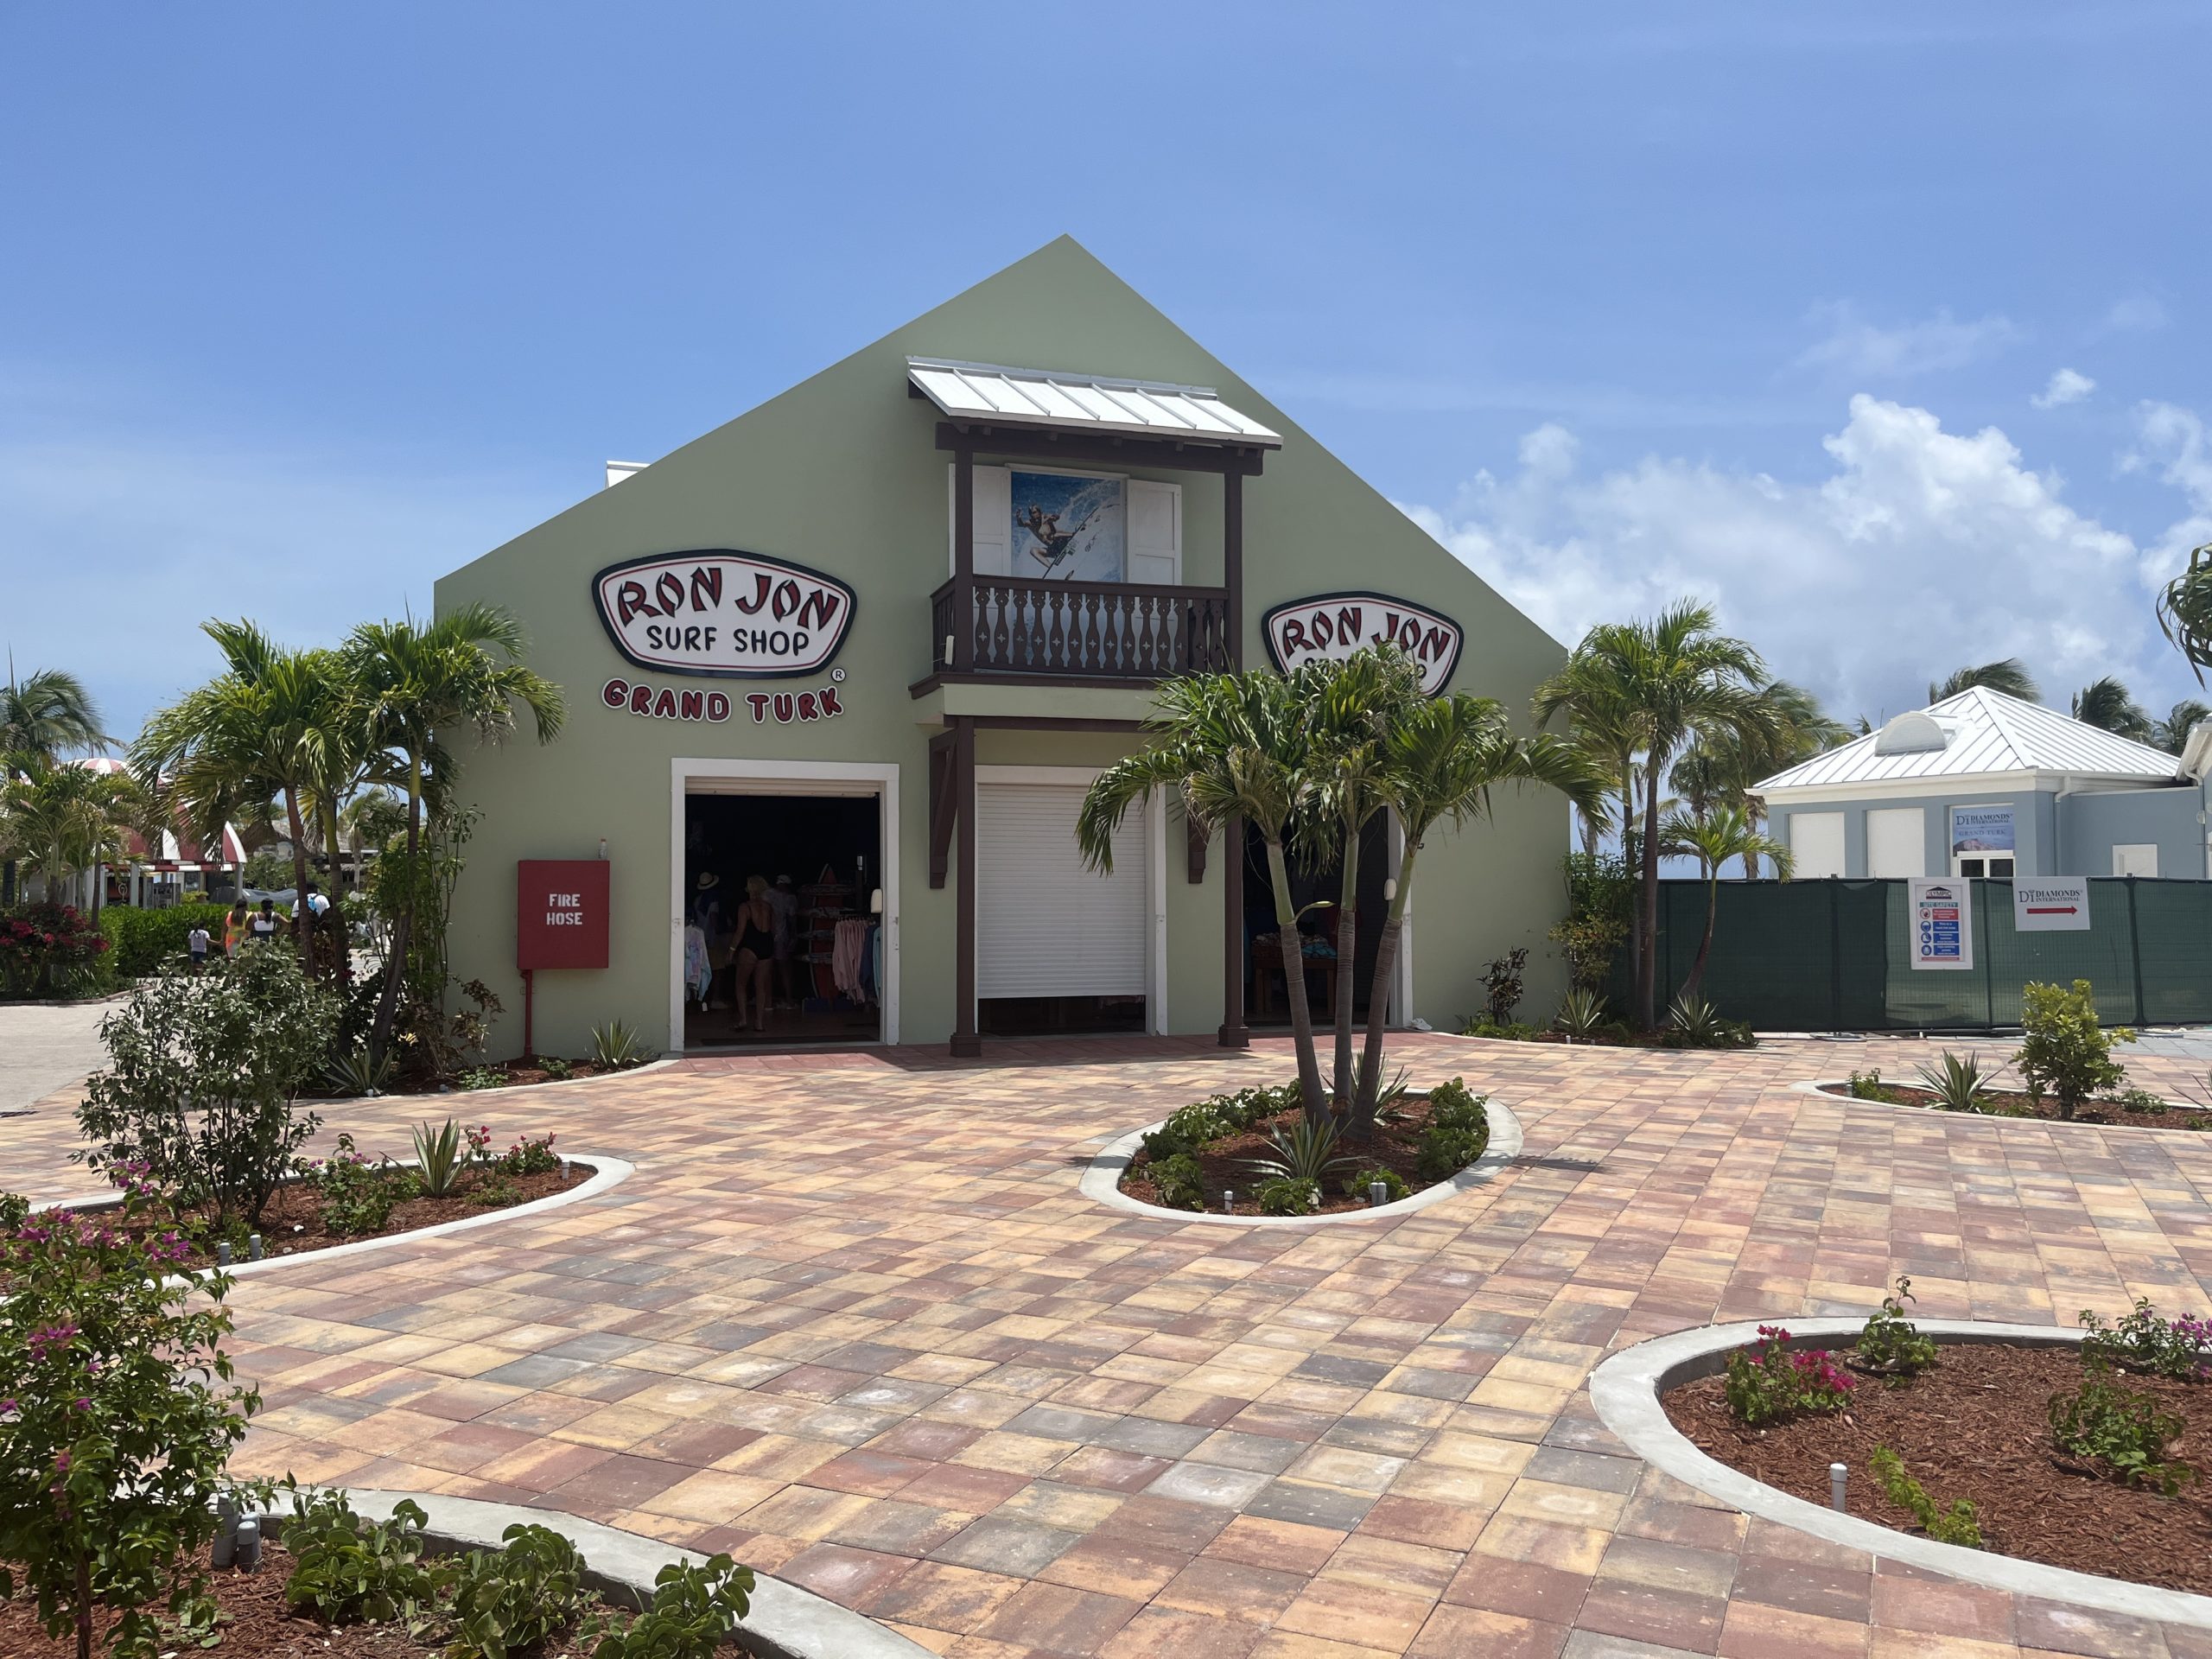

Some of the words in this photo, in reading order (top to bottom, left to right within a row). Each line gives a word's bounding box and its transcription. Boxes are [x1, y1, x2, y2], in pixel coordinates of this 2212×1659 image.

[618, 566, 722, 628] RON
[734, 572, 841, 632] JON
[646, 625, 717, 652] SURF
[733, 628, 810, 657] SHOP
[1282, 607, 1362, 659] RON
[1370, 612, 1452, 664] JON
[602, 678, 731, 721] GRAND
[745, 686, 844, 724] TURK
[546, 912, 583, 925] HOSE
[549, 893, 581, 907] FIRE
